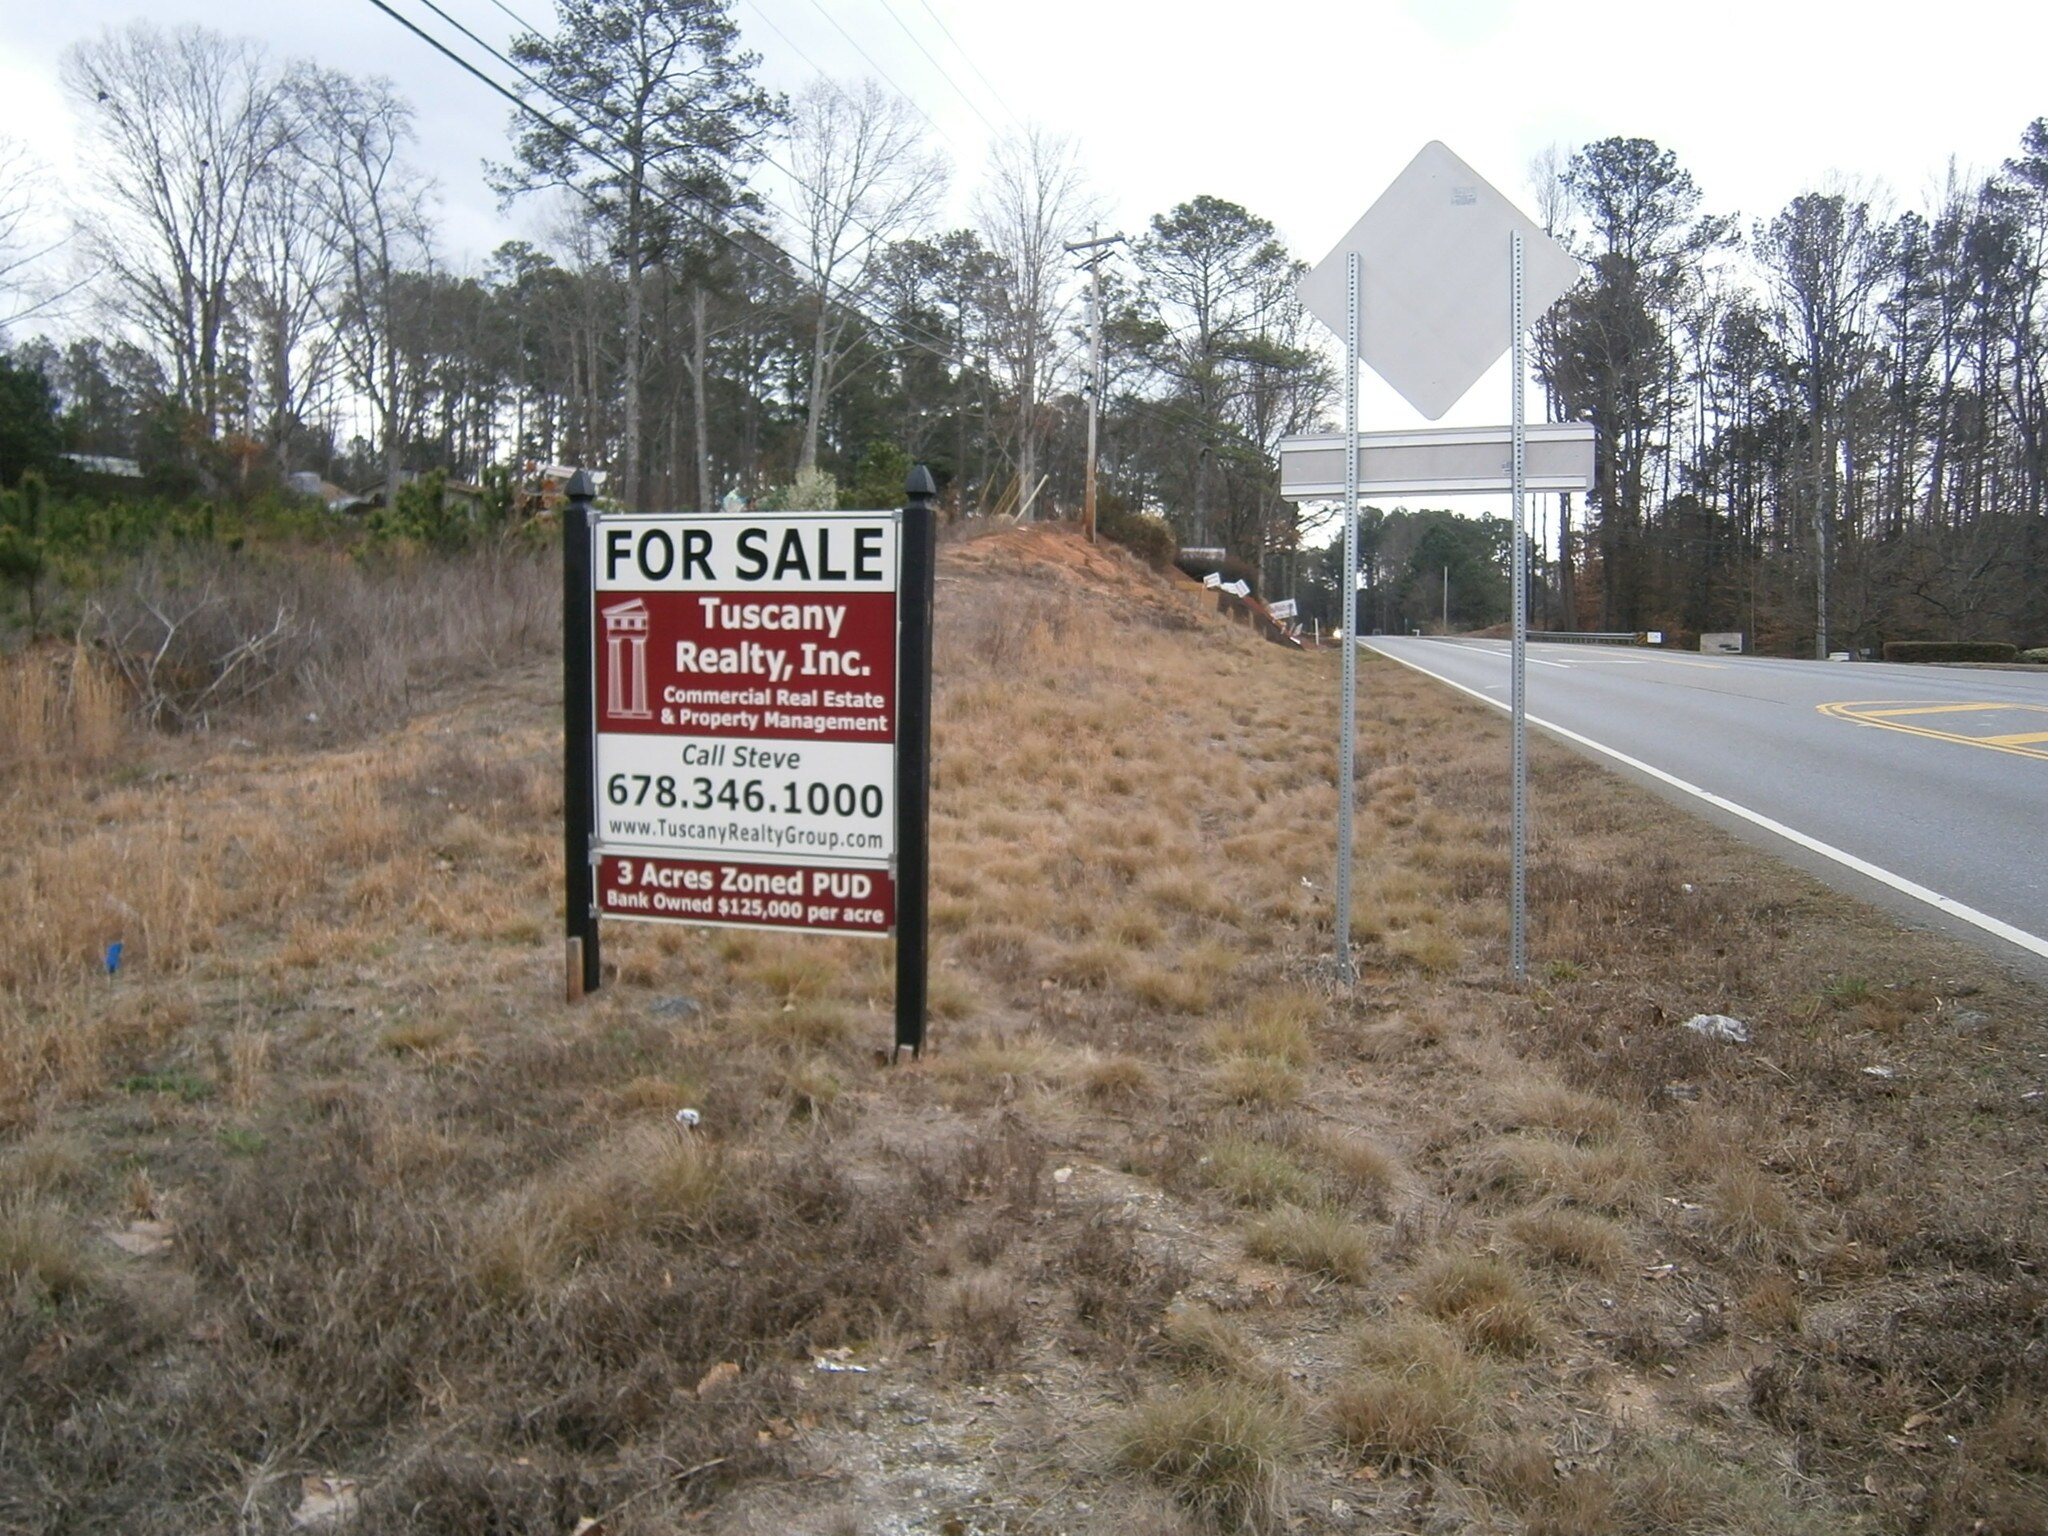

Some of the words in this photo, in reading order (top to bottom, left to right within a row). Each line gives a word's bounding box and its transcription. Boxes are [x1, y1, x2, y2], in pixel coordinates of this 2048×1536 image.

[606, 528, 716, 581] FOR
[735, 527, 883, 581] SALE
[699, 597, 846, 638] Tuscany
[676, 641, 792, 682] Realty,
[801, 644, 870, 676] Inc.
[664, 686, 770, 705] Commercial
[777, 687, 817, 706] Real
[823, 690, 884, 709] Estate
[661, 709, 674, 725] &
[680, 709, 757, 730] Property
[764, 711, 888, 733] Management
[682, 744, 724, 767] Call
[733, 746, 800, 769] Steve
[607, 773, 883, 818] 678.346.1000
[609, 819, 883, 850] www.TuscanyRealtyGroup.com
[617, 861, 633, 885] 3
[641, 864, 713, 890] Acres
[721, 867, 803, 895] Zoned
[812, 874, 871, 899] PUD
[607, 890, 648, 909] Bank
[653, 893, 713, 913] Owned
[718, 897, 802, 921] $125,000
[808, 906, 839, 923] per
[843, 909, 884, 924] acre
